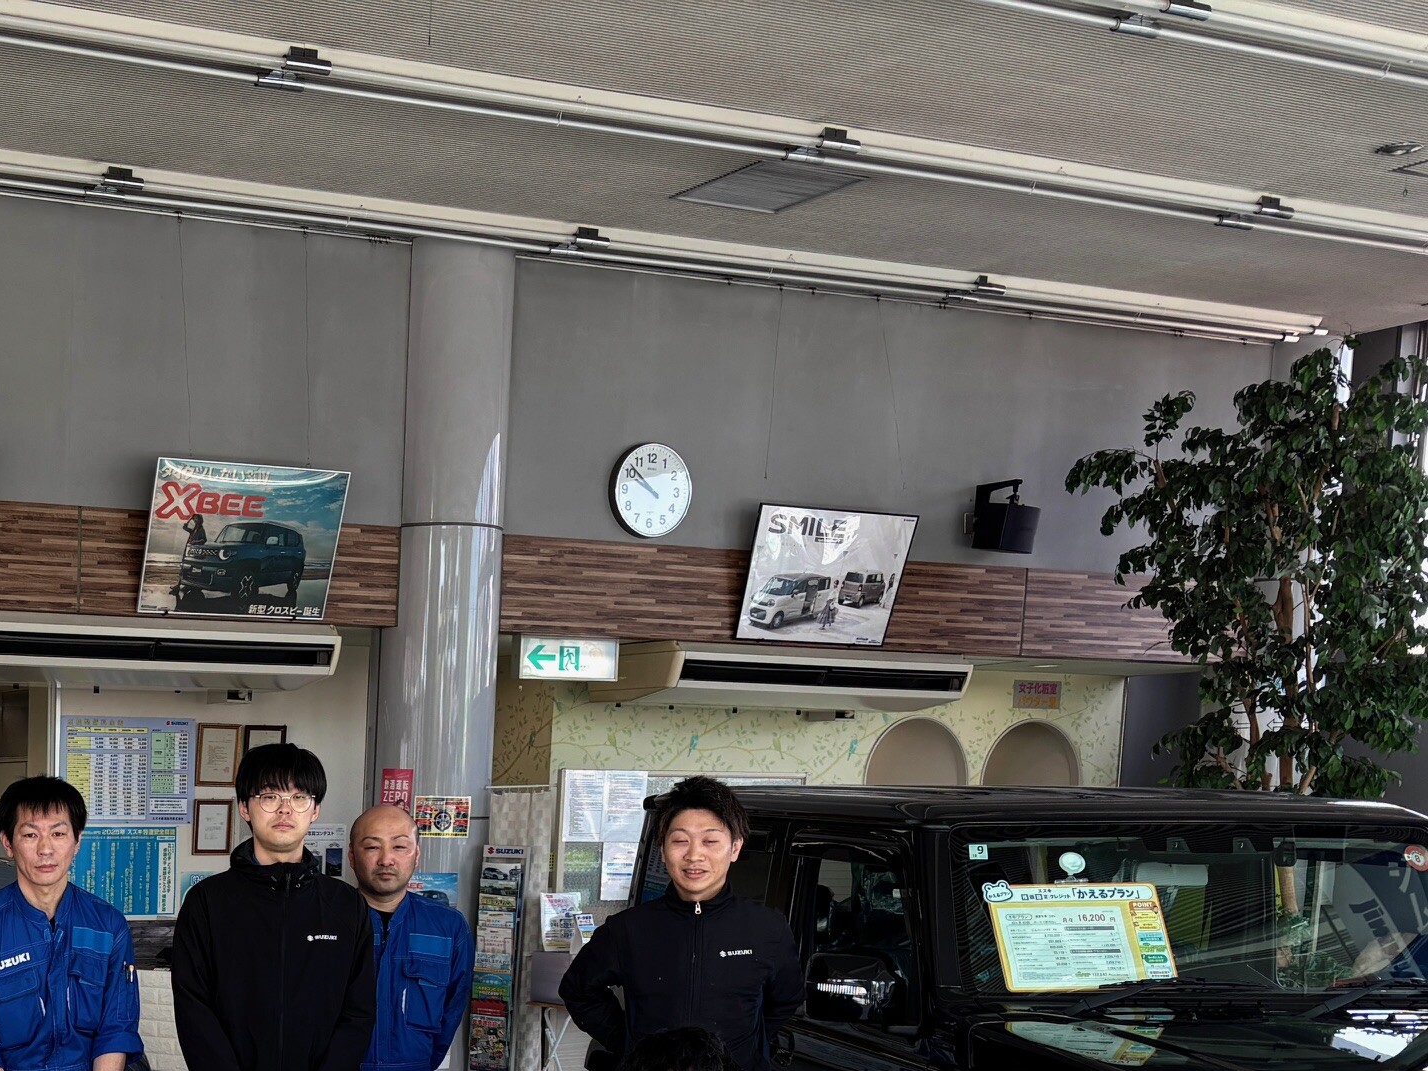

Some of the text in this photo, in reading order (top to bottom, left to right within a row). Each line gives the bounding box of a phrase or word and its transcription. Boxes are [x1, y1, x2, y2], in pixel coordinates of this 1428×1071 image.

[634, 456, 644, 467] 11
[647, 453, 658, 464] 12
[662, 458, 667, 469] 1
[625, 467, 636, 479] 10
[670, 470, 678, 481] 2
[621, 483, 629, 494] 9
[673, 487, 680, 498] 3
[155, 481, 267, 520] XBEE
[624, 500, 632, 511] 8
[668, 503, 676, 514] 4
[633, 513, 640, 523] 7
[645, 518, 653, 529] 6
[659, 514, 667, 525] 5
[768, 513, 848, 540] SMILE
[383, 790, 409, 803] ZERO
[977, 845, 984, 855] 9
[1077, 913, 1106, 923] 16,200
[314, 934, 338, 942] SUZUKI
[727, 949, 753, 957] SUZUKI
